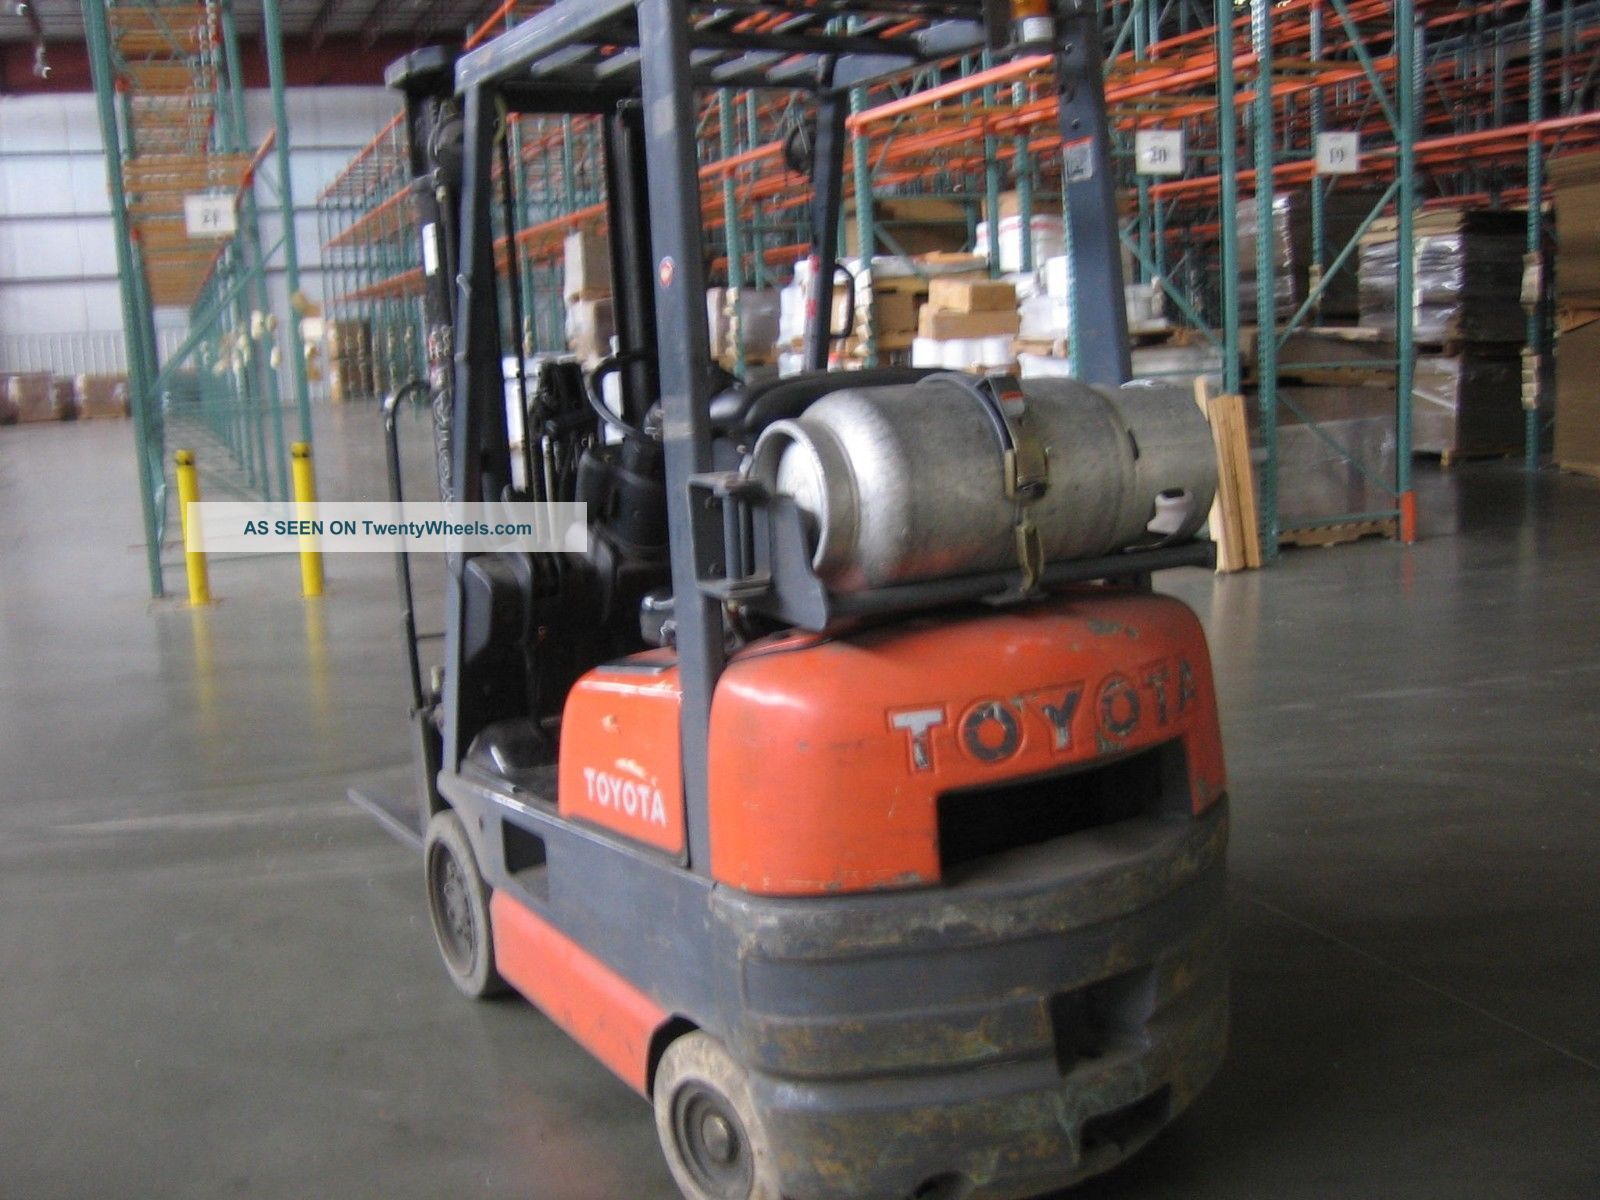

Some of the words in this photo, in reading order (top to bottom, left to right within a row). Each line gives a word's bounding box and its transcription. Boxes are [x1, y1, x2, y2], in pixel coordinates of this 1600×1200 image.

[1329, 147, 1345, 164] 19
[890, 657, 1198, 770] TOYOTA
[582, 766, 668, 828] TOYOTA
